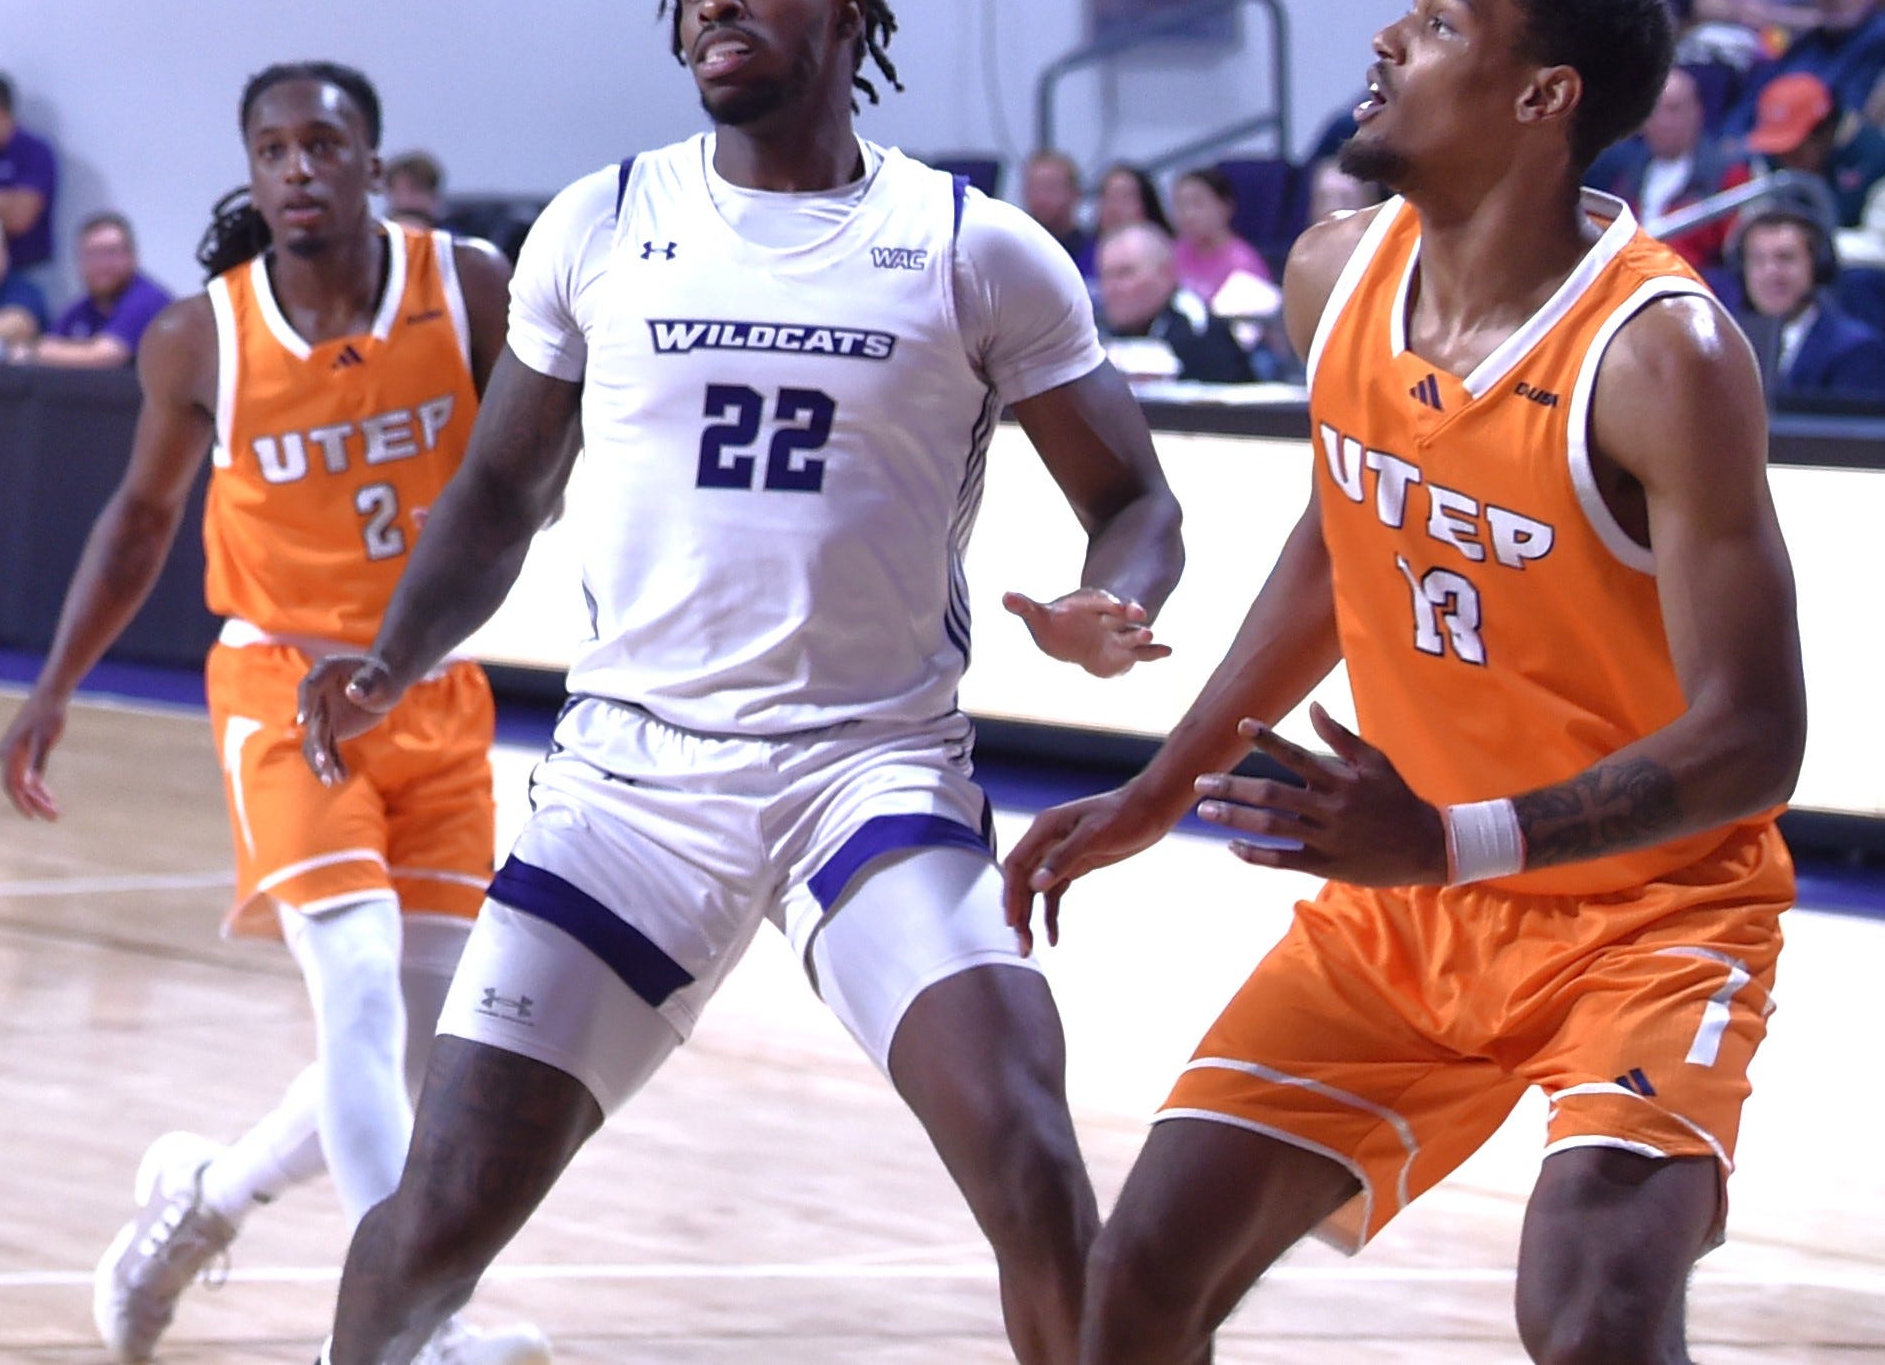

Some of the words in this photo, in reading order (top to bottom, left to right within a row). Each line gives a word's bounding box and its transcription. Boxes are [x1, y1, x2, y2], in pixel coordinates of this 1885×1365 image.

[871, 247, 927, 270] WAC
[651, 322, 895, 360] WILDCATS
[252, 394, 456, 483] UTEP
[695, 383, 838, 492] 22
[1319, 422, 1554, 570] UTEP
[1396, 552, 1488, 667] 13
